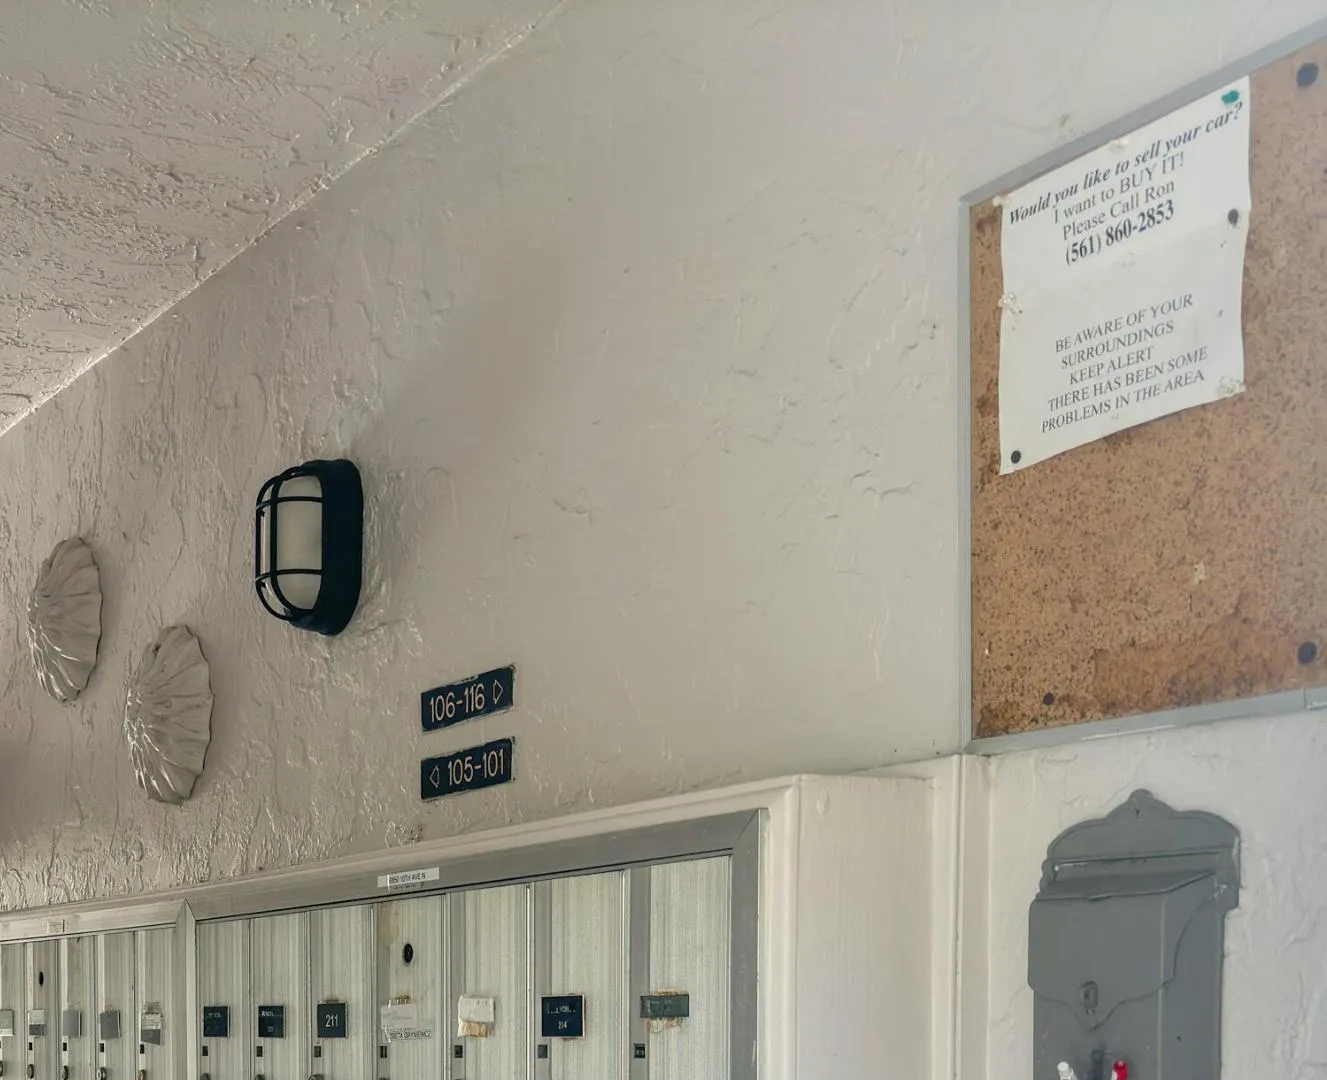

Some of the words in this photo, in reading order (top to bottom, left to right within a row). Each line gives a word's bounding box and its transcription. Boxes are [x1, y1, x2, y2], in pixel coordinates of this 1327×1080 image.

[1009, 194, 1050, 225] Would
[1052, 184, 1078, 206] you
[1083, 170, 1111, 190] like
[1115, 160, 1130, 176] to
[1134, 140, 1161, 167] sell
[1163, 126, 1201, 152] your
[1205, 101, 1244, 133] car?
[1053, 209, 1060, 225] I
[1064, 195, 1097, 220] want
[1101, 186, 1115, 202] to
[1119, 164, 1158, 195] BUY
[1161, 151, 1185, 175] IT!
[1063, 209, 1105, 241] Please
[1110, 192, 1140, 219] Call
[1145, 181, 1175, 204] Ron
[1065, 234, 1102, 266] (561)
[1105, 200, 1175, 247] 860-2853
[1055, 336, 1073, 353] BE
[1073, 316, 1123, 346] AWARE
[1126, 308, 1147, 327] OF
[1150, 293, 1194, 319] YOUR
[1060, 320, 1175, 370] SURROUNDINGS
[1048, 386, 1090, 413] THERE
[1093, 376, 1122, 398] HAS
[1125, 362, 1165, 388] BEEN
[1167, 346, 1209, 373] SOME
[1069, 363, 1105, 386] KEEP
[1106, 345, 1154, 374] ALERT
[1041, 399, 1112, 434] PROBLEMS
[1115, 393, 1132, 409] IN
[1133, 383, 1161, 401] THE
[1163, 368, 1205, 394] AREA
[429, 682, 486, 724] 106-116
[446, 748, 505, 787] 105-101
[325, 1013, 340, 1029] 211
